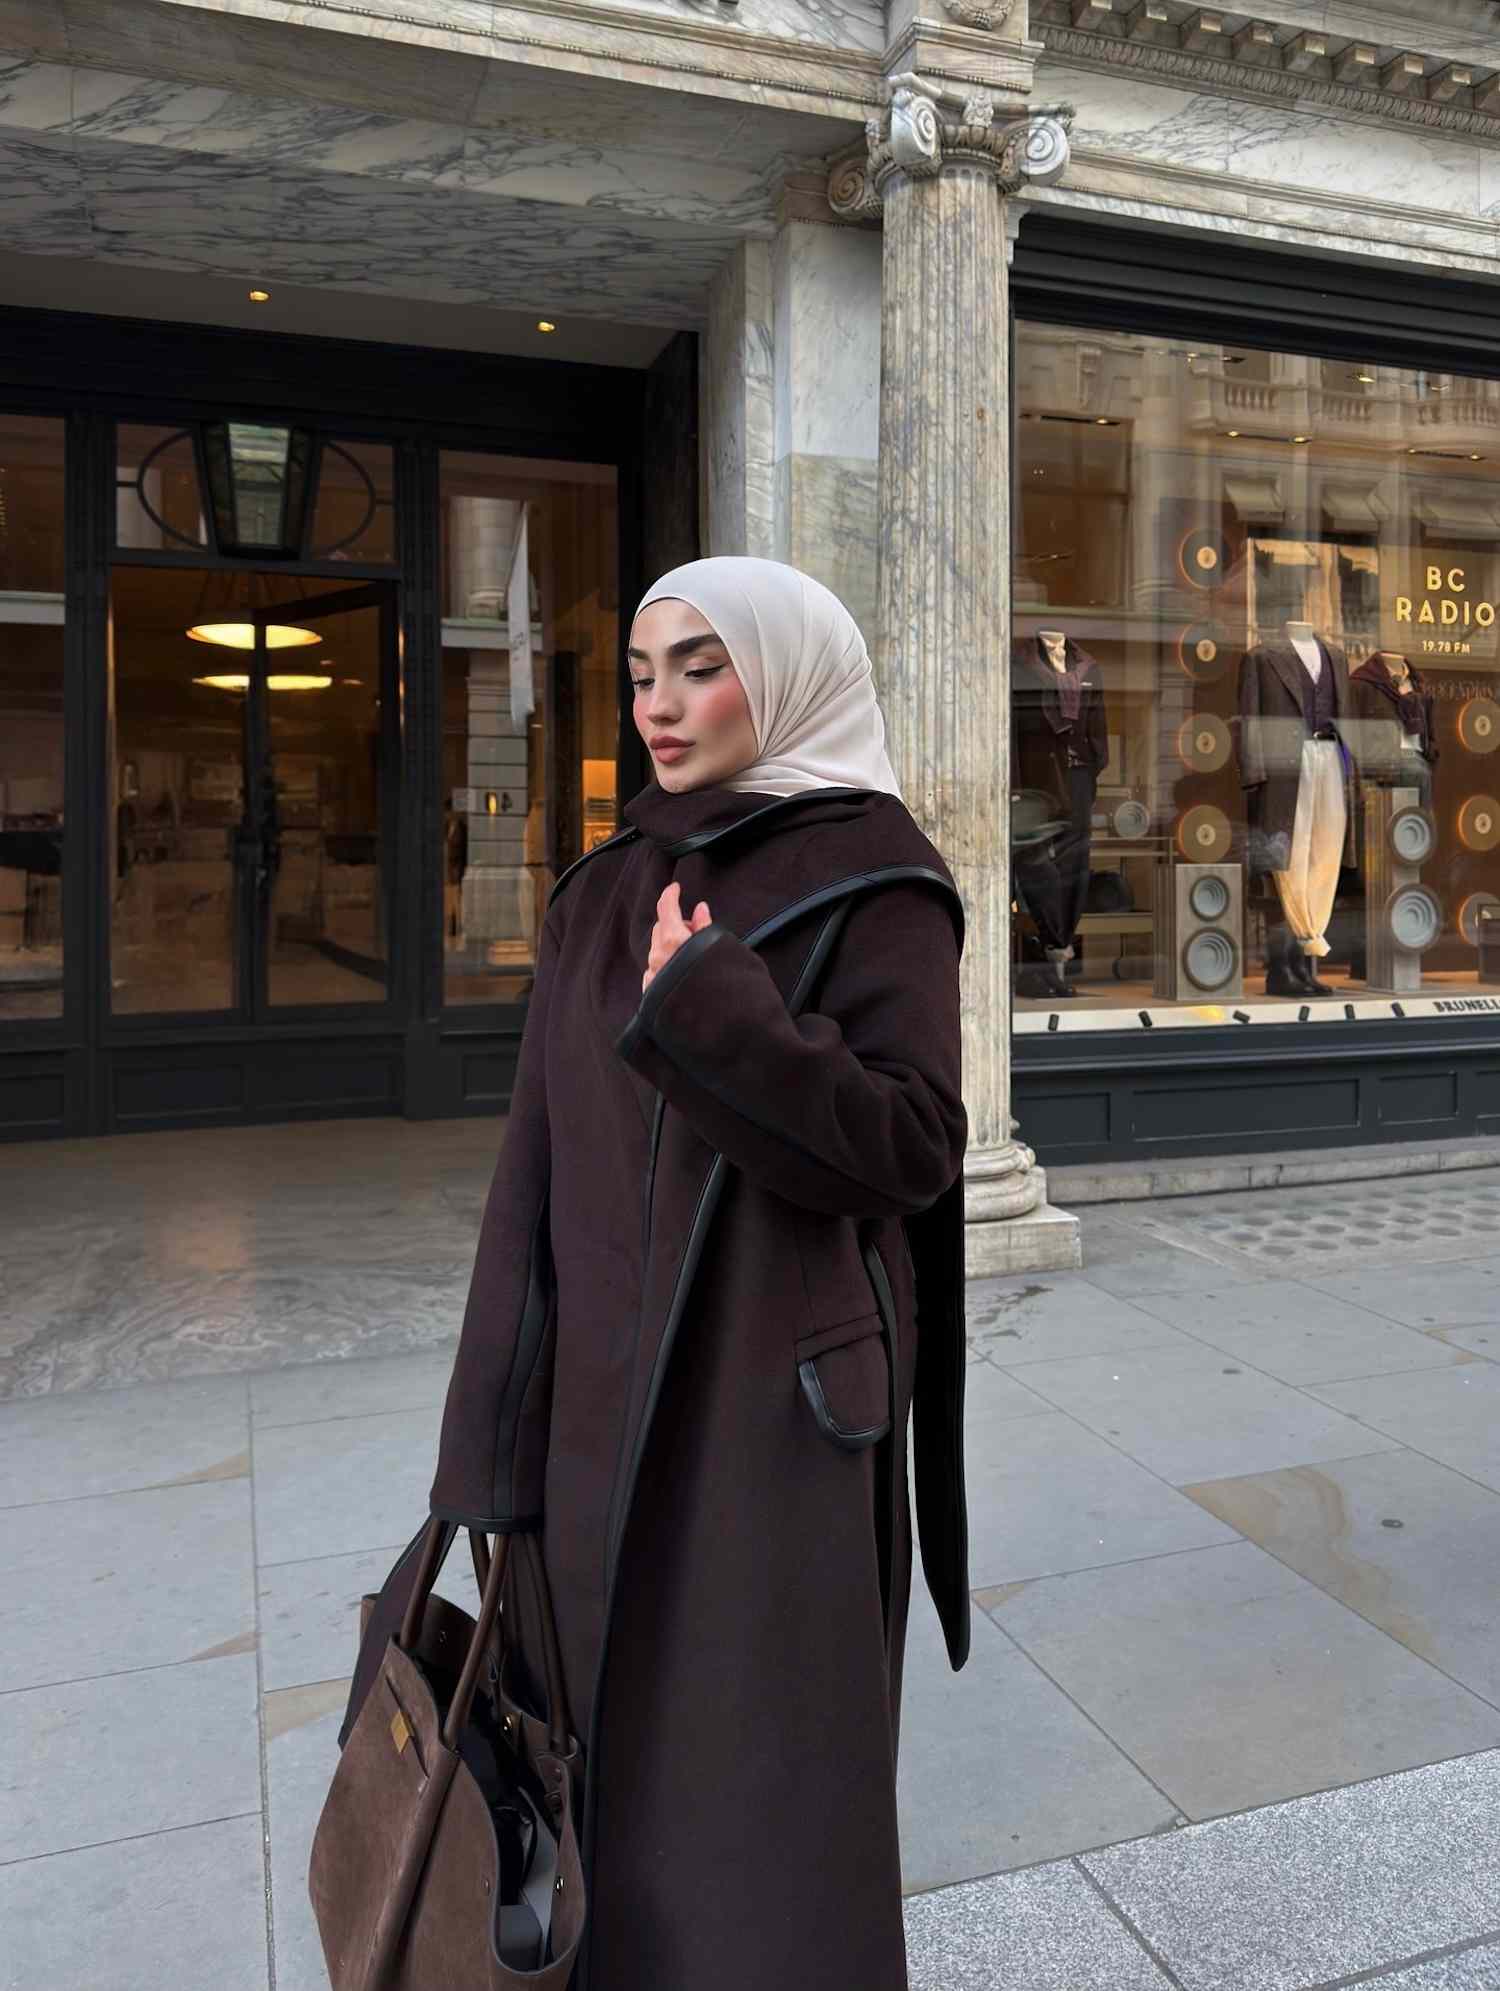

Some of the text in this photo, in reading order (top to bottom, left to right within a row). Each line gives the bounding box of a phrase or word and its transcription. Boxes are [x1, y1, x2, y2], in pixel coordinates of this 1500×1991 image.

[1427, 566, 1465, 592] BC
[1396, 597, 1495, 626] RADIO
[1454, 642, 1471, 654] FM
[1432, 999, 1500, 1012] BRUNELL
